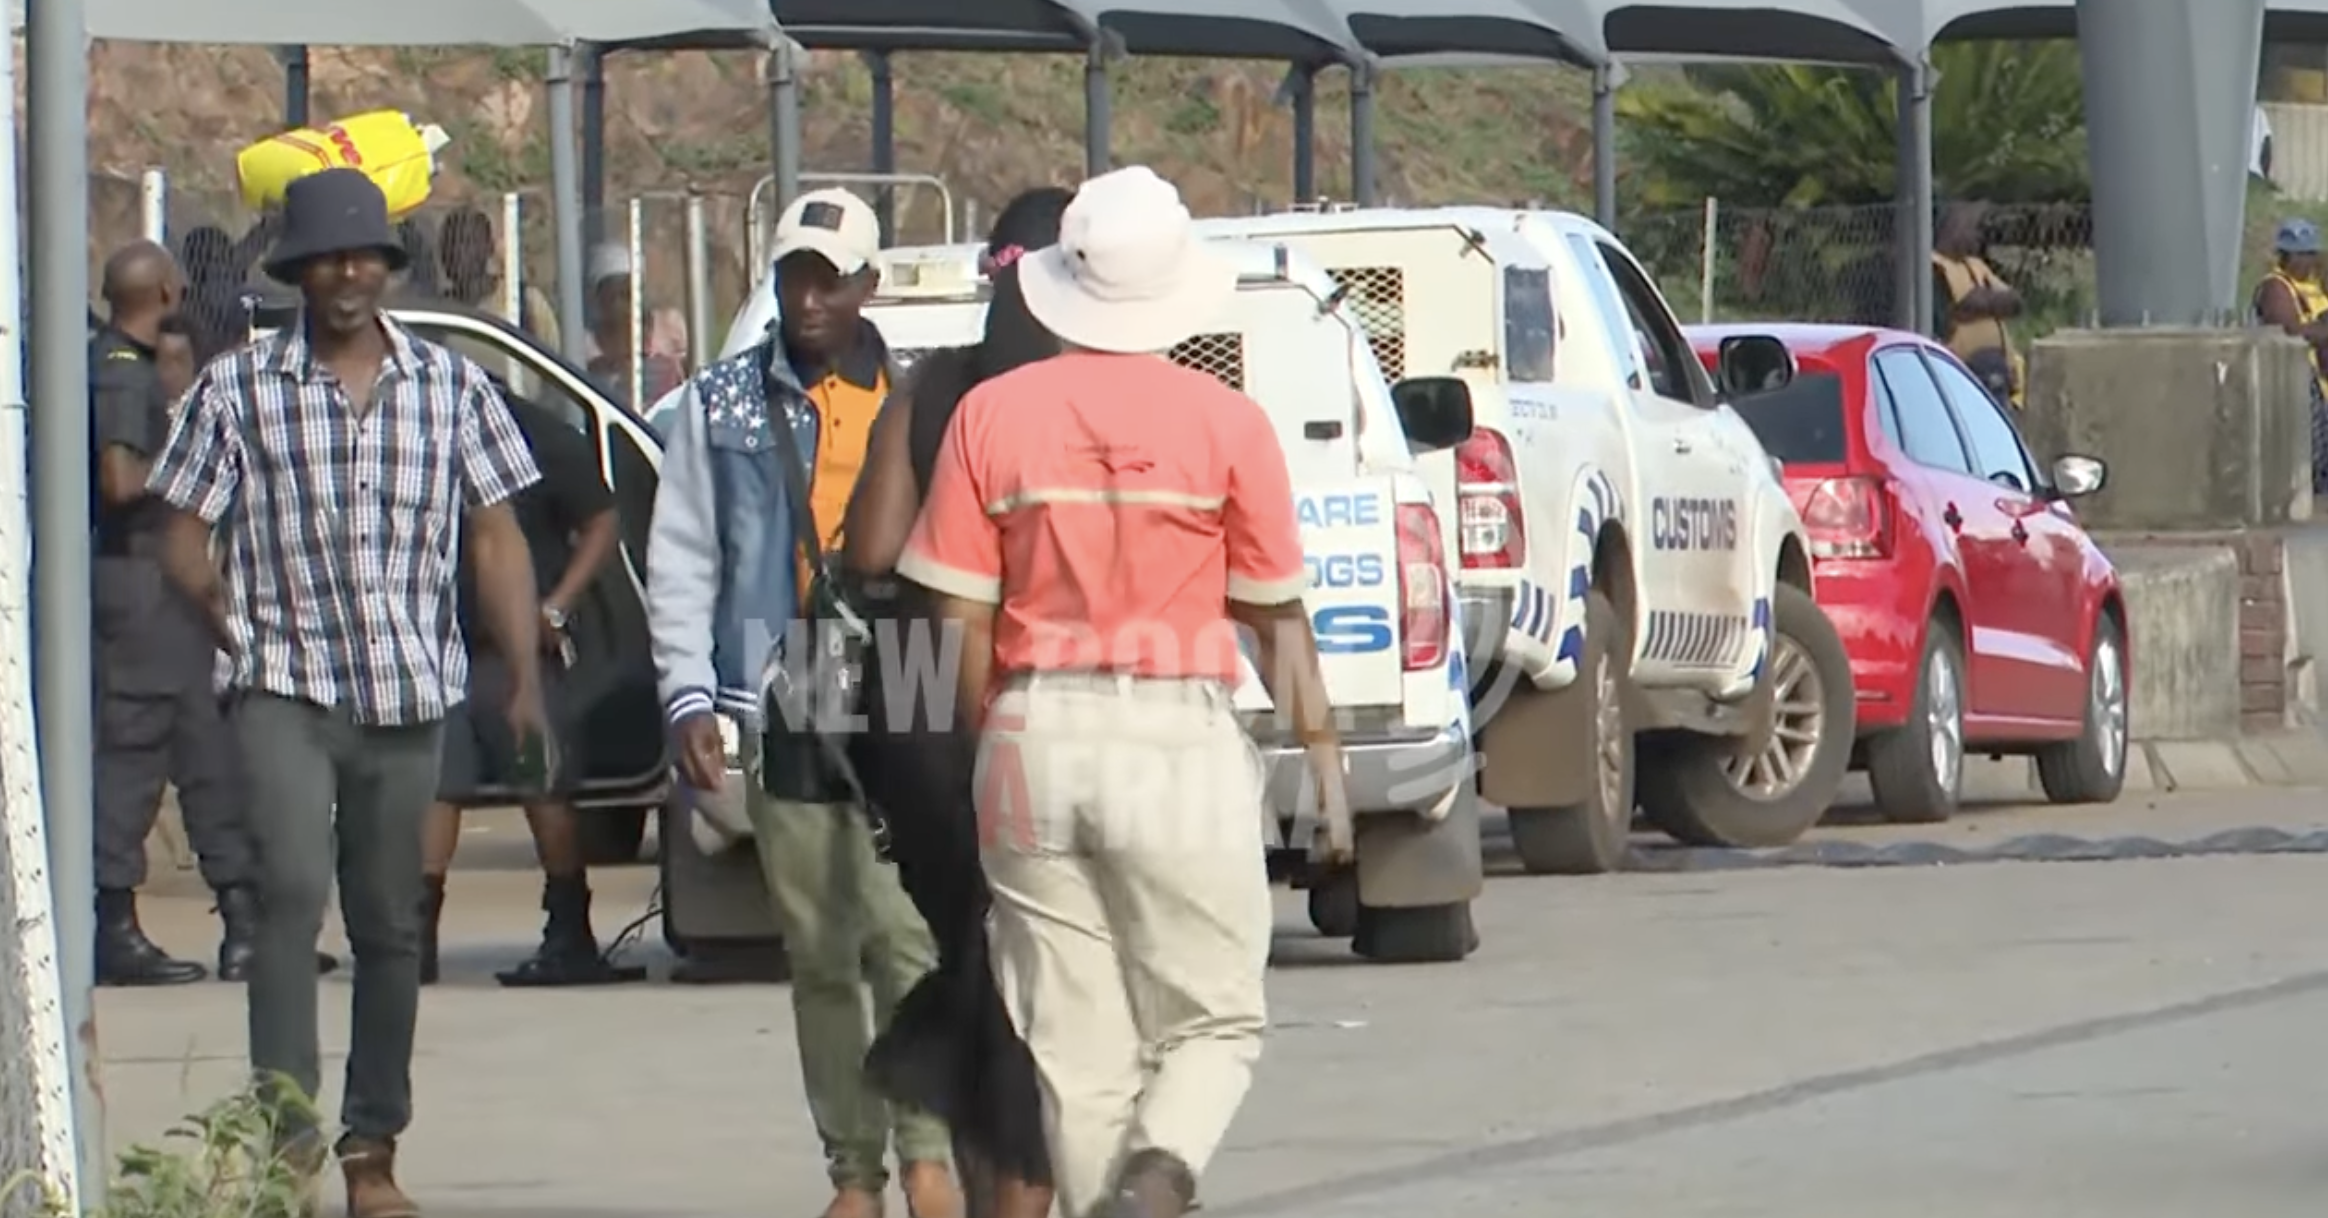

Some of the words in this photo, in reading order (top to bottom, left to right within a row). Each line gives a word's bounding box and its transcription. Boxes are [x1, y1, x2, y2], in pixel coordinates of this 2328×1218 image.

[1296, 493, 1379, 527] ARE
[1653, 497, 1736, 550] CUSTOMS
[1303, 553, 1384, 588] OGS
[1313, 605, 1392, 654] S
